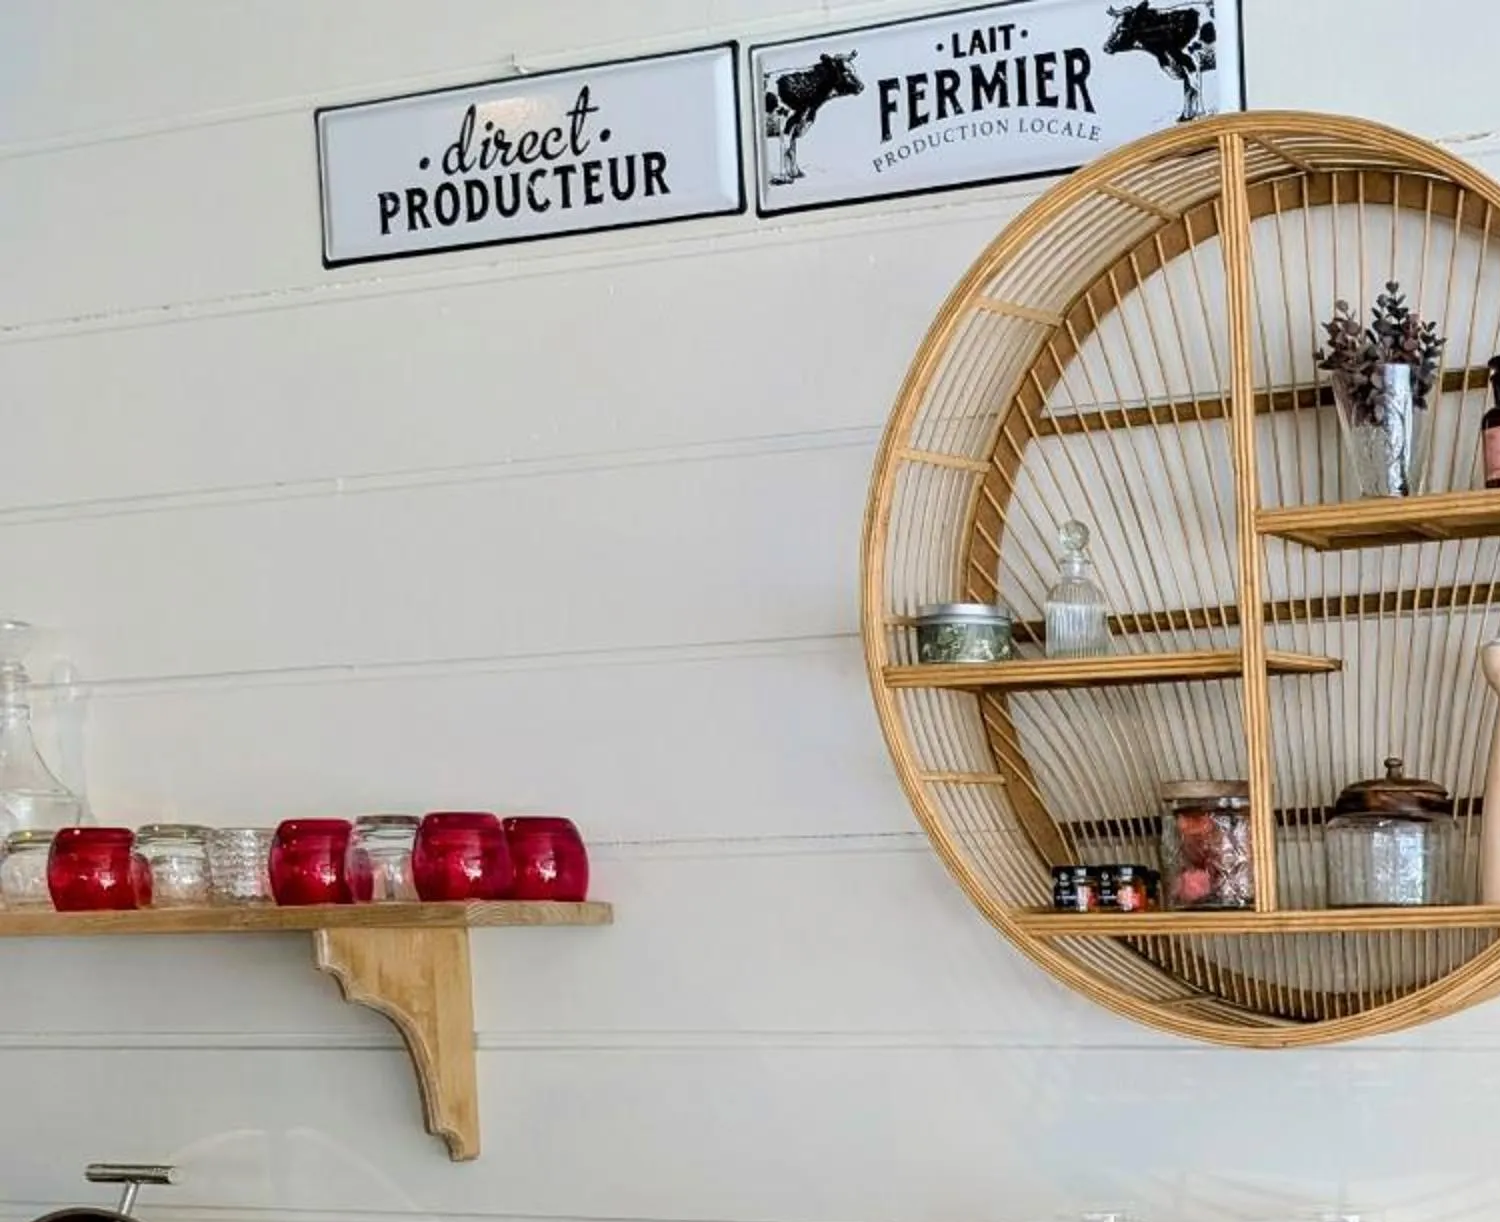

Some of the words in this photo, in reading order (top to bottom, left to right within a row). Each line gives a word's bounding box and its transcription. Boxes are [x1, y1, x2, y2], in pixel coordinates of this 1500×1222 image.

[952, 23, 1017, 61] LAIT
[441, 86, 598, 177] direct
[878, 58, 1098, 144] FERMIER
[871, 118, 1012, 174] PRODUCTION
[1018, 116, 1103, 143] LOCALE
[377, 150, 672, 236] PRODUCTEUR
